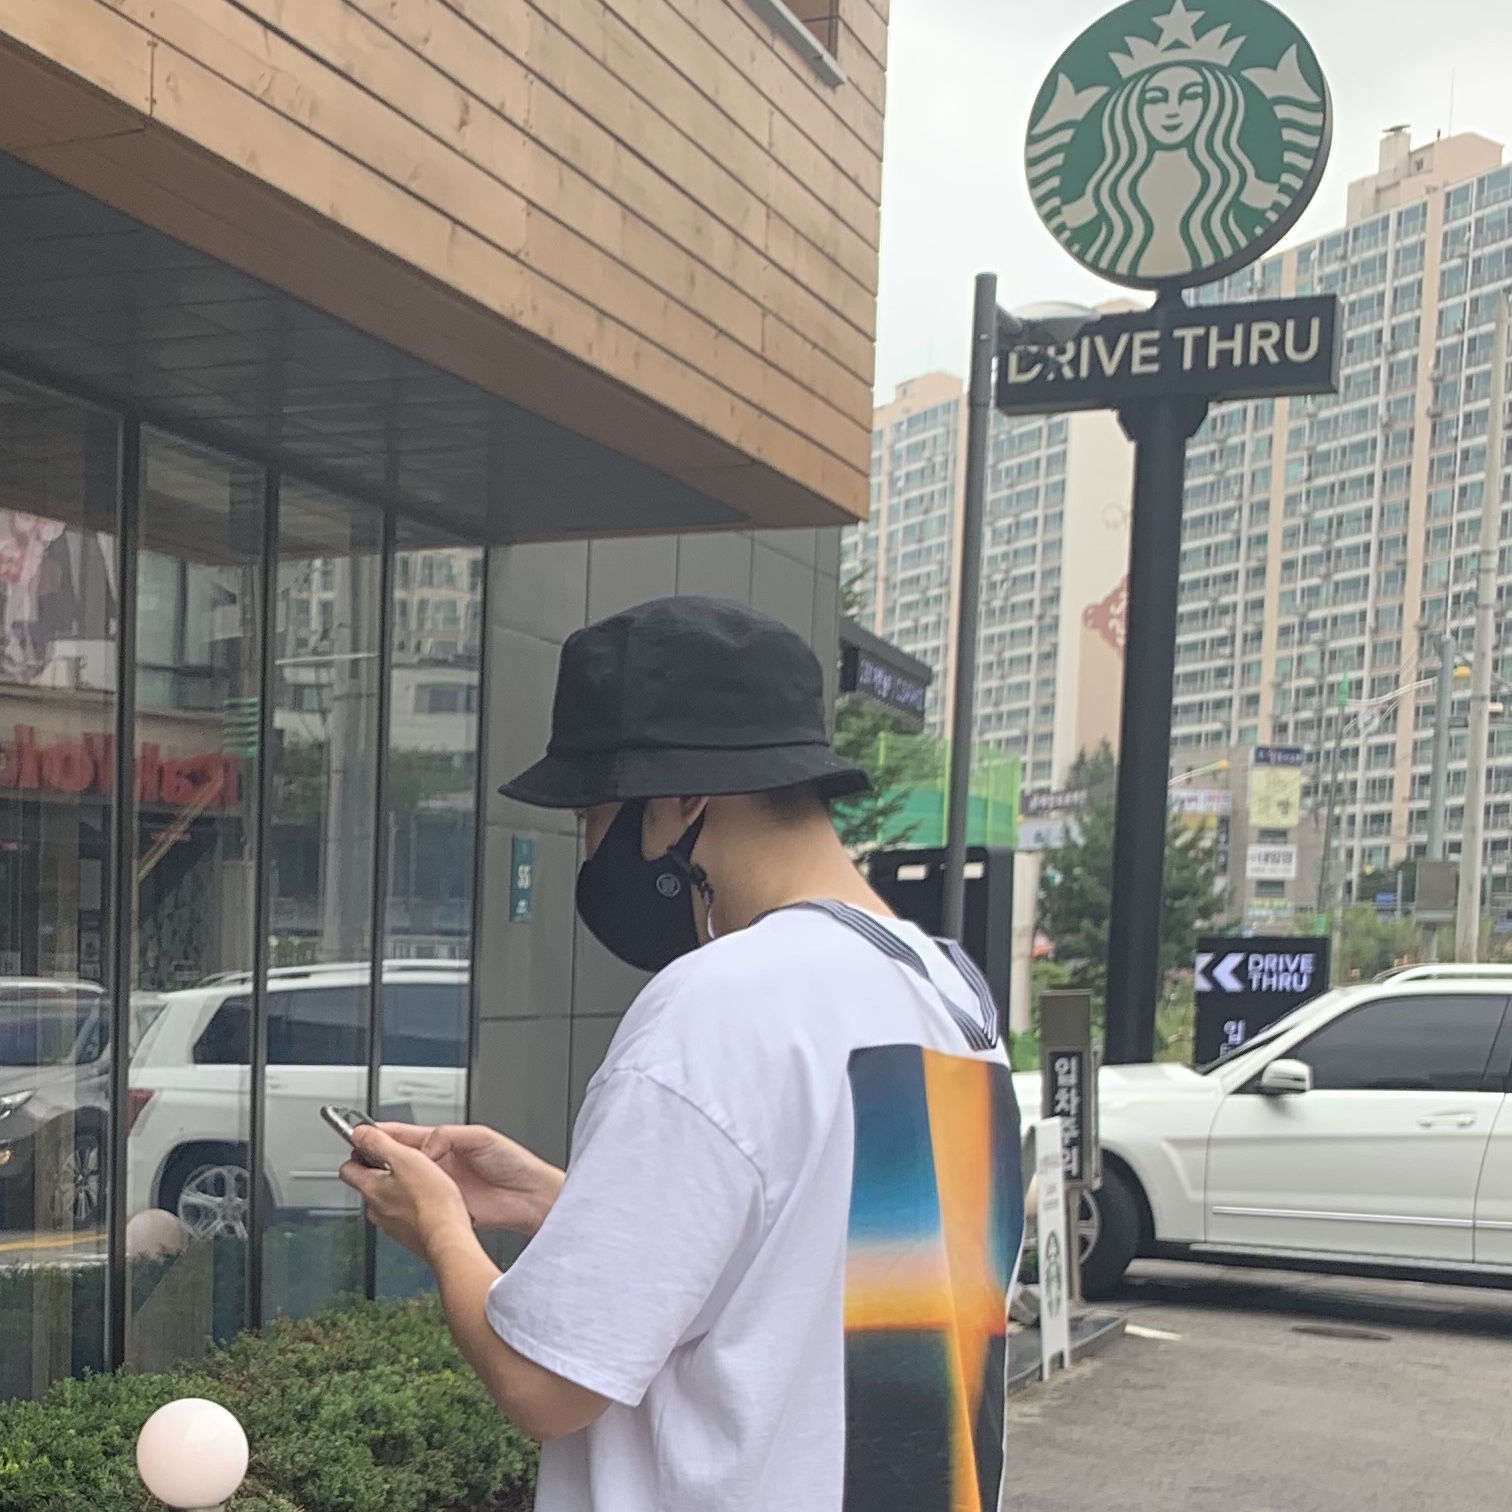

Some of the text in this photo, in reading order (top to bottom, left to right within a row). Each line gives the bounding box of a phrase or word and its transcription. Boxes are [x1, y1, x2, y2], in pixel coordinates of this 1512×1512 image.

[1007, 316, 1321, 385] DRIVE THRU
[1248, 953, 1315, 974] DRIVE
[1248, 971, 1310, 993] THRU
